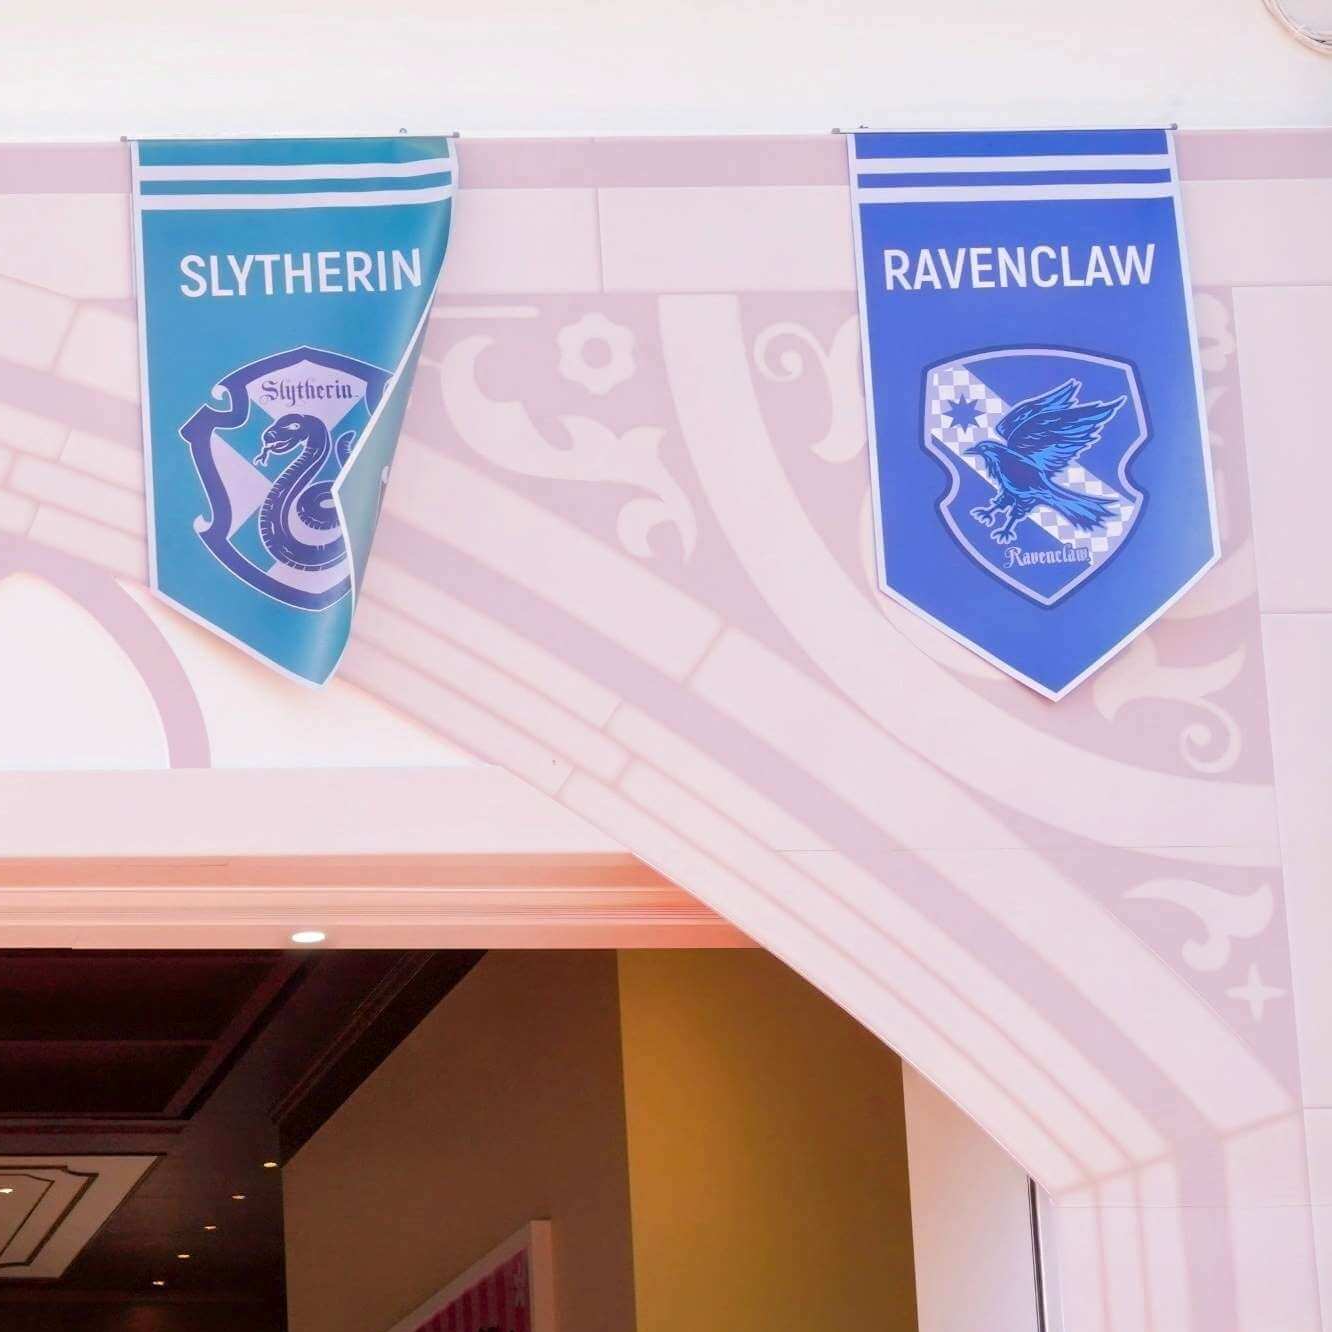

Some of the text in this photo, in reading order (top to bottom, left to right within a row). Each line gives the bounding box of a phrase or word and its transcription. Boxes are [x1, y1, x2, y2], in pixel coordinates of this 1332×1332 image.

[178, 247, 424, 299] SLYTHERIN
[882, 242, 1157, 292] RAVENCLAW
[259, 378, 354, 407] Slytherin
[1003, 543, 1089, 569] Ravenclaw
